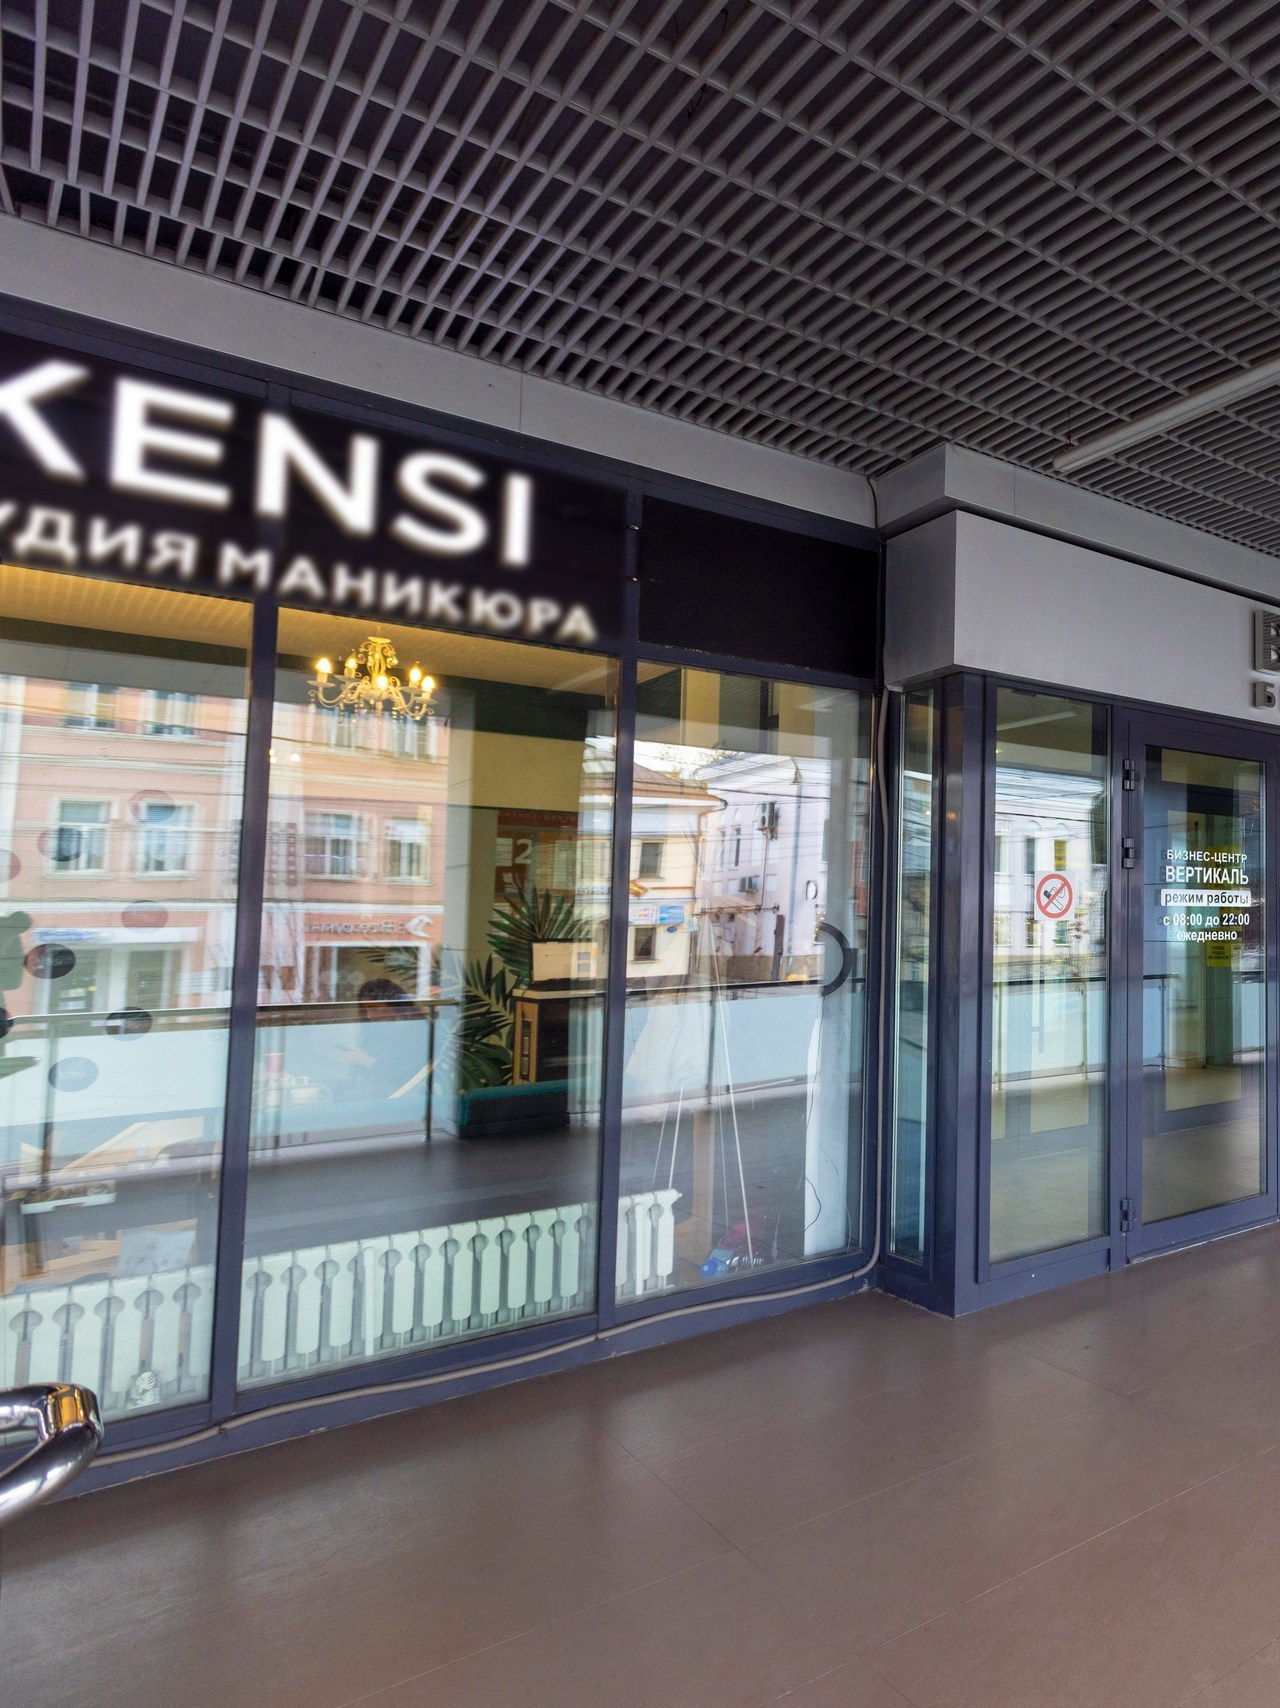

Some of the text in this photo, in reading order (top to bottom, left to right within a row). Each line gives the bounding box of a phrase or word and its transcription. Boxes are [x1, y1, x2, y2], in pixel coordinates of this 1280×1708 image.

[216, 541, 598, 645] МАНИКЮРА
[1167, 850, 1248, 864] БИЗНЕС-ЦЕНТР
[1165, 866, 1249, 885] ВЕРТИКАЛЬ
[1165, 892, 1249, 906] режим работы
[1163, 913, 1250, 928] с 08:00 до 22:00
[1177, 930, 1238, 943] ежедневно
